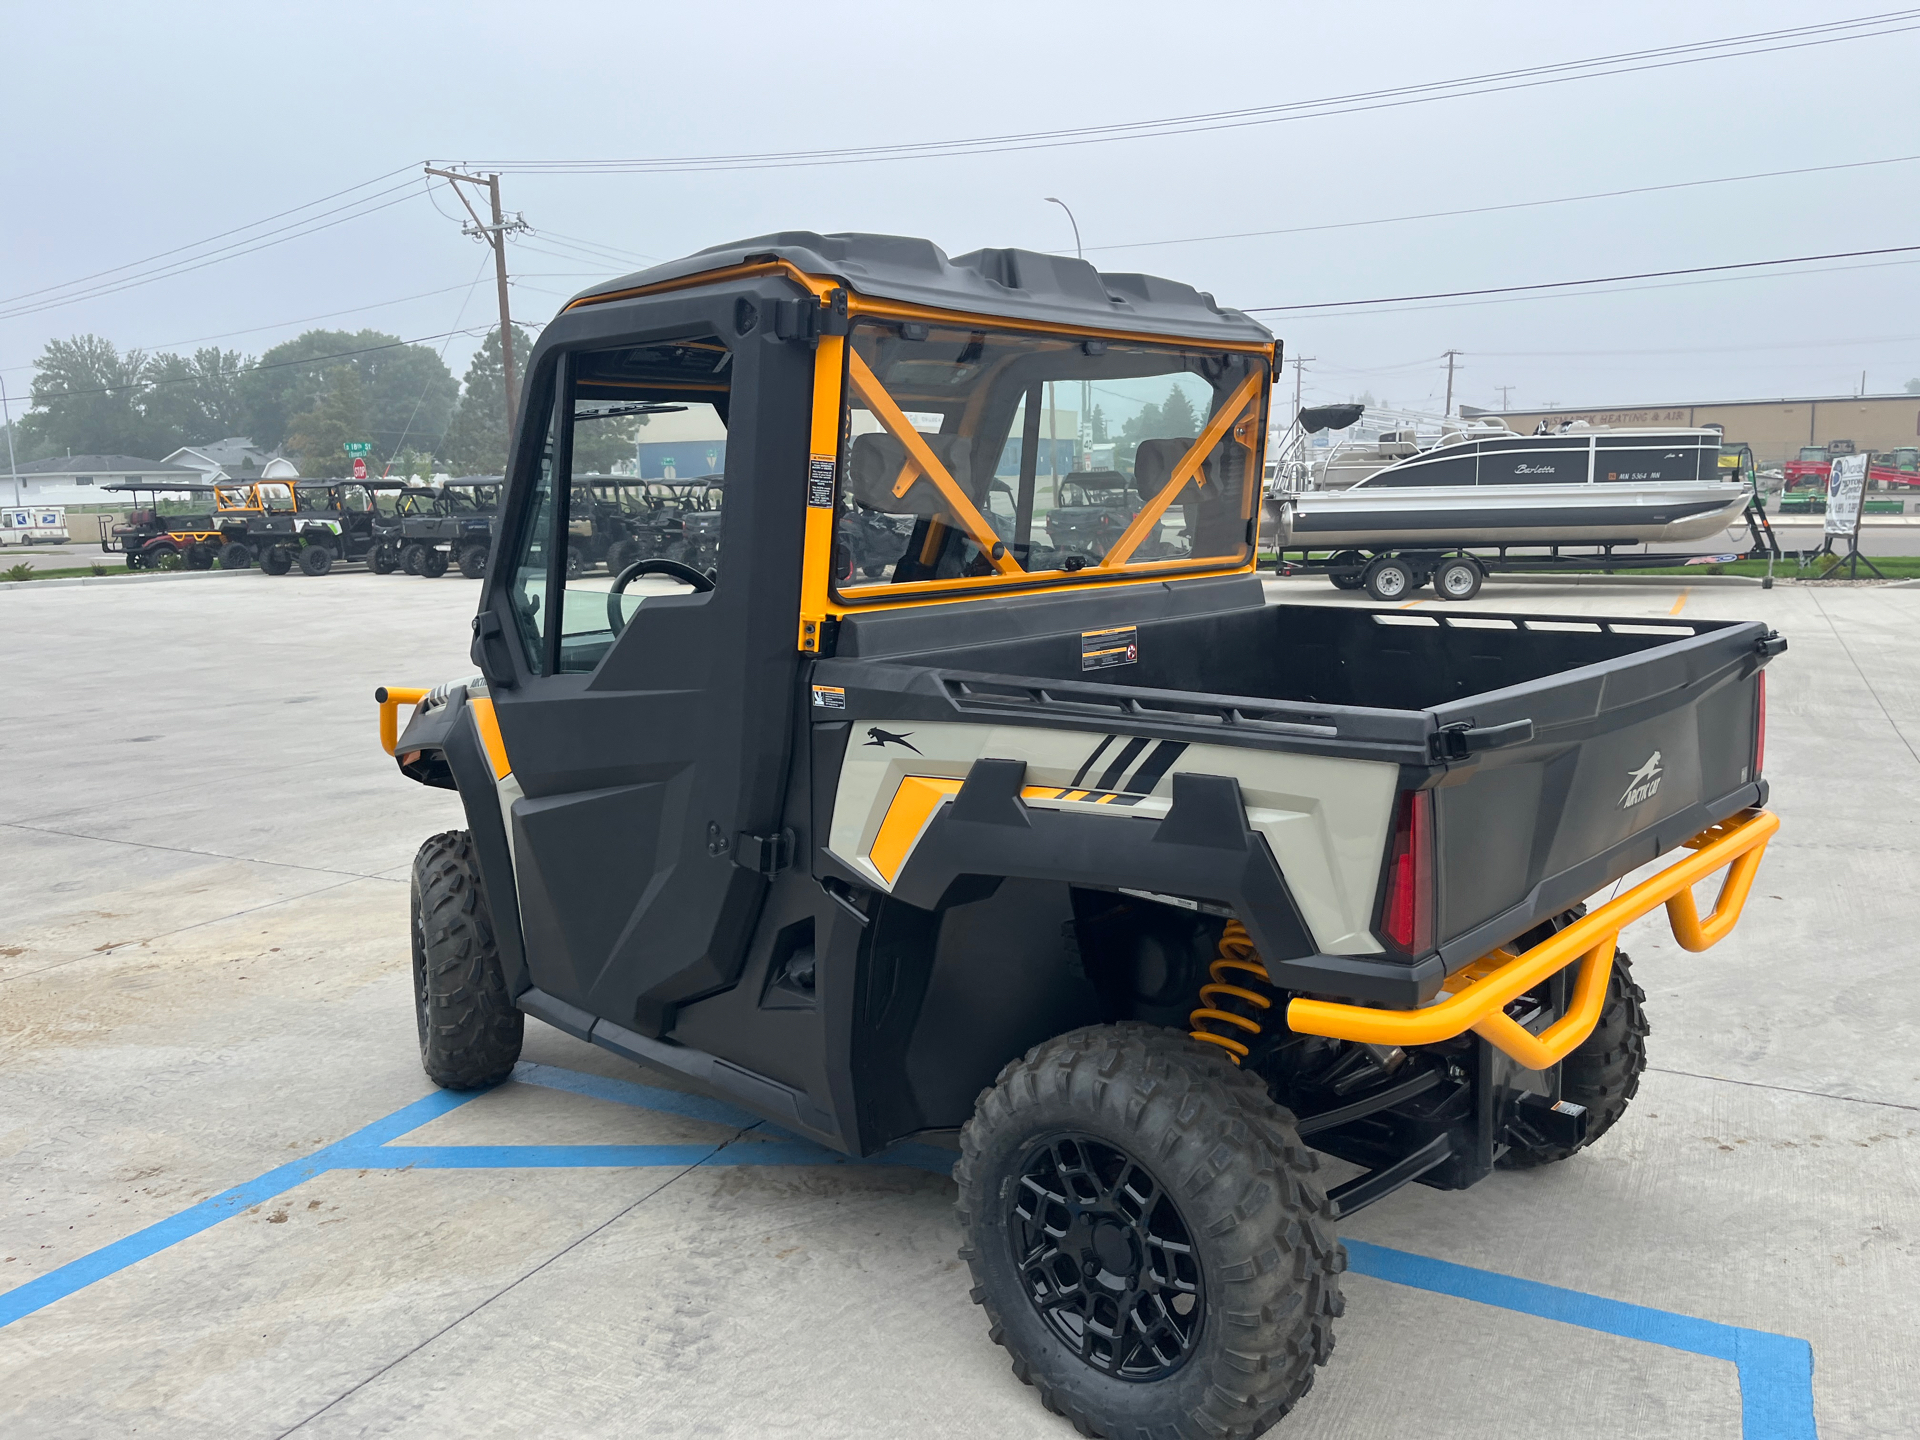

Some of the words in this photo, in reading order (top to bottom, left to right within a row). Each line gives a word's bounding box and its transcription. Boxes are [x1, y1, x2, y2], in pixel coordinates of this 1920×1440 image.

[1600, 412, 1648, 424] HEATING
[1651, 411, 1660, 421] &
[1663, 410, 1685, 421] AIR
[1084, 440, 1092, 450] 40
[354, 466, 365, 477] STOP
[1514, 464, 1555, 474] Barletta
[1623, 783, 1650, 809] ARCTIC
[1648, 777, 1661, 797] CAT
